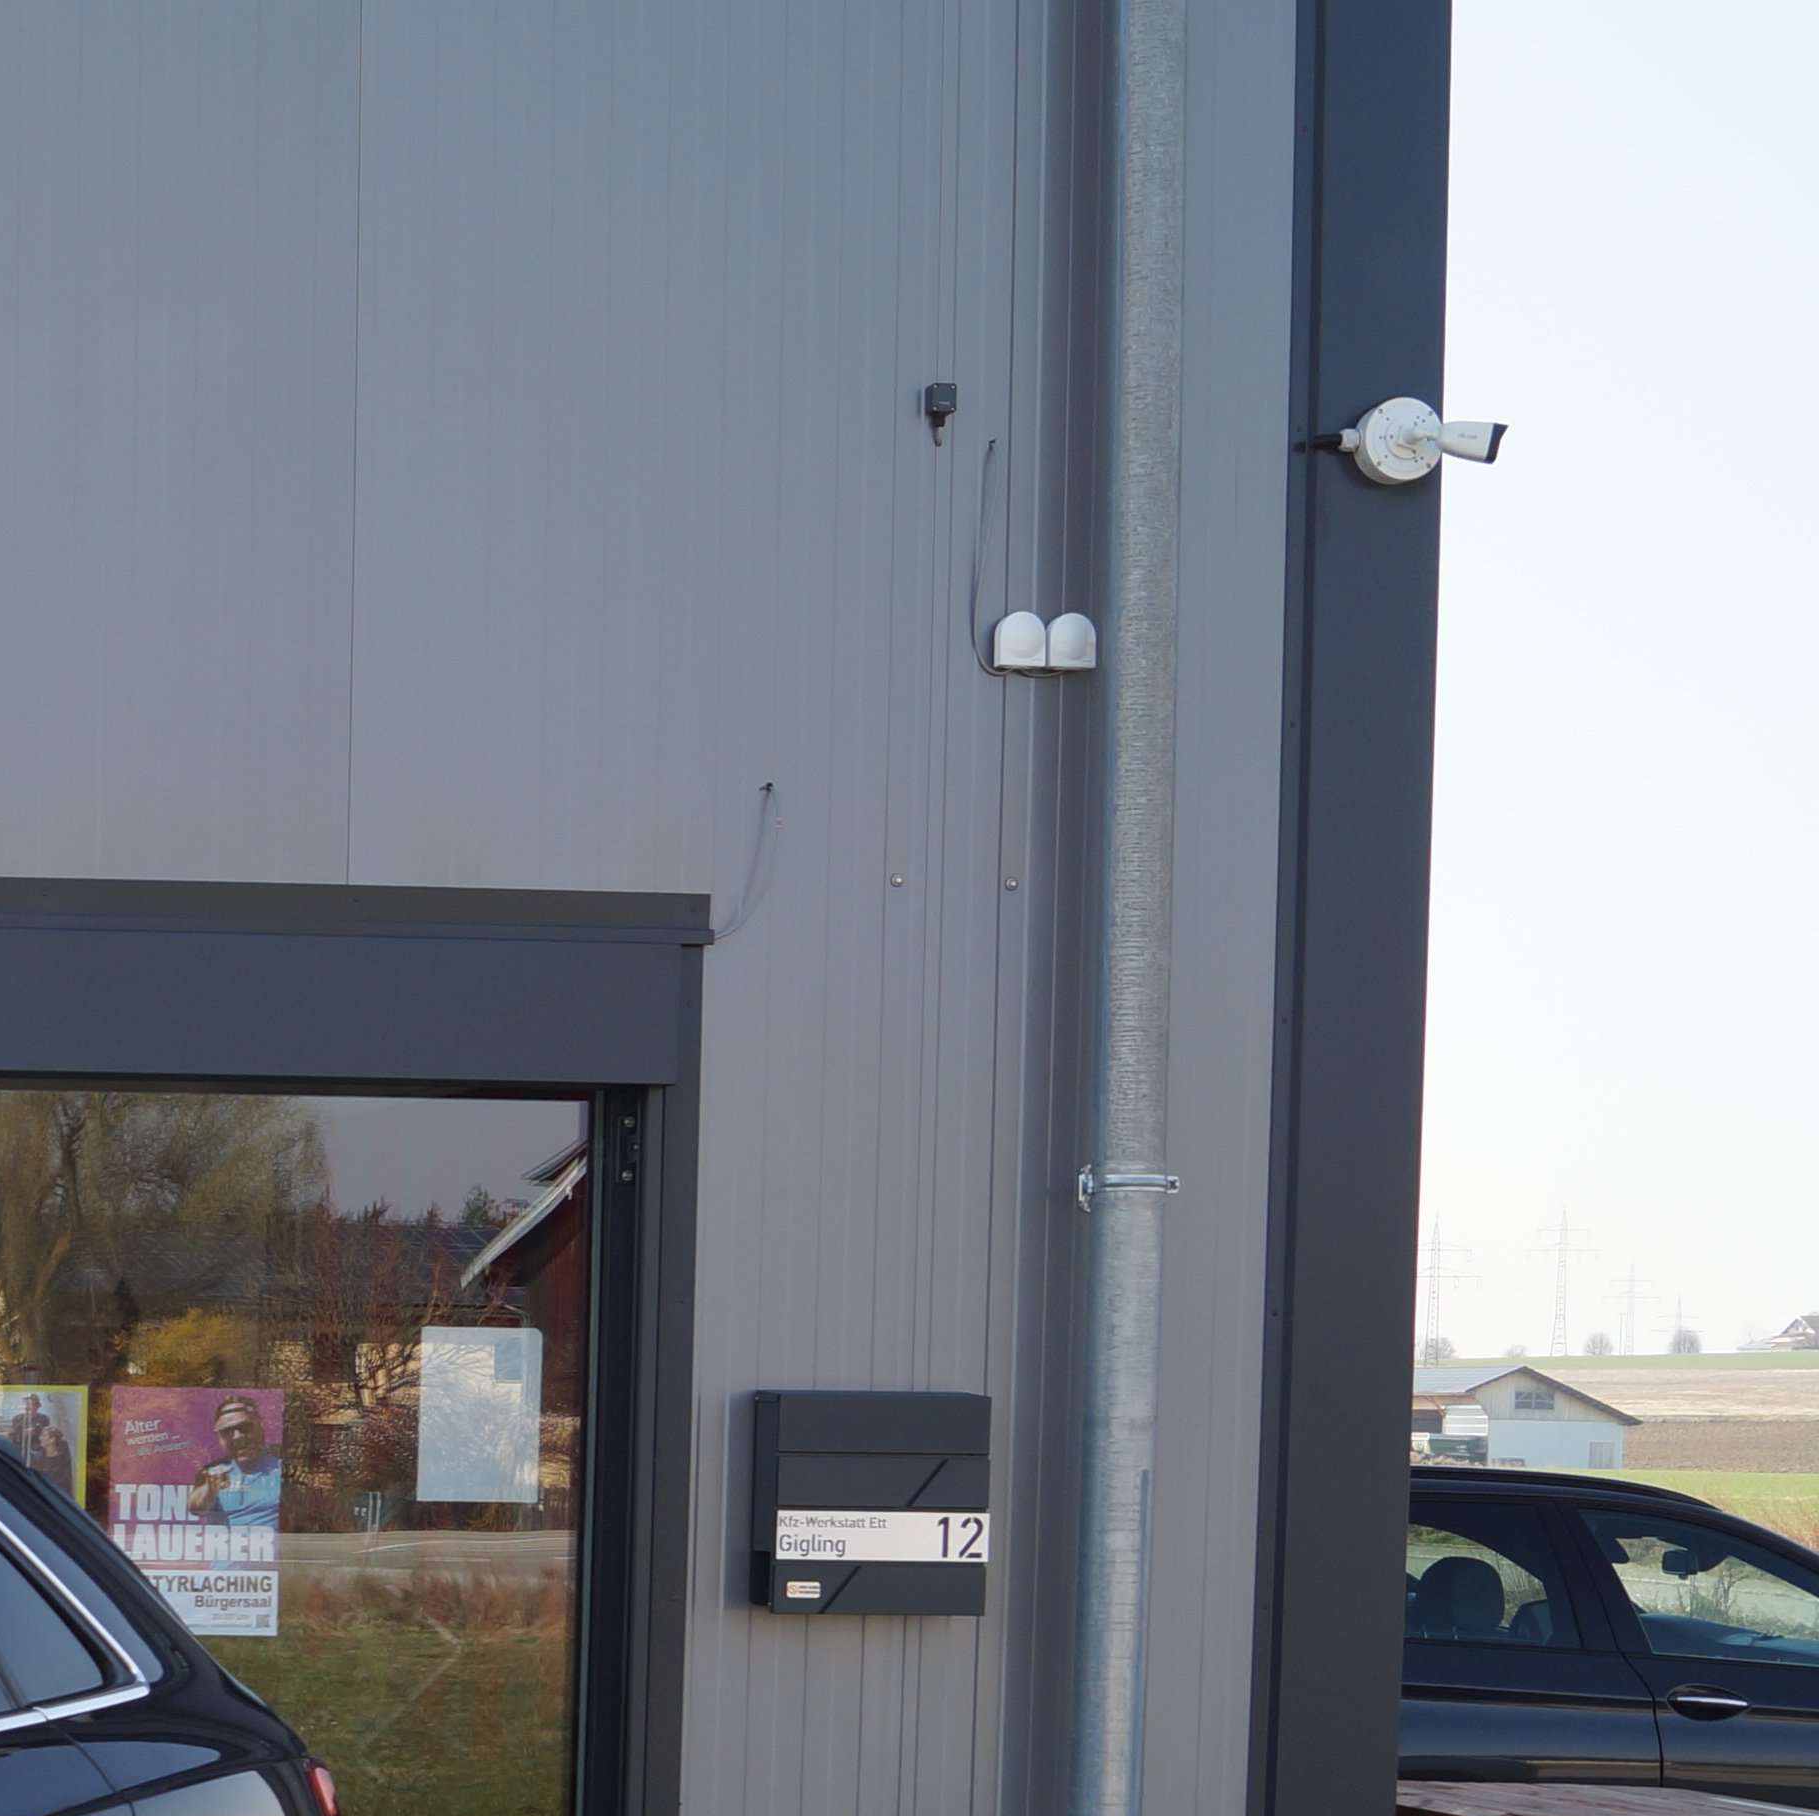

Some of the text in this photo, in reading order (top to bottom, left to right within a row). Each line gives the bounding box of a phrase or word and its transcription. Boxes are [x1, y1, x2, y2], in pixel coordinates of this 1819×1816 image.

[778, 1515, 887, 1528] Kfz-Werkstatt Ett
[778, 1534, 846, 1557] Gigling
[937, 1517, 984, 1559] 12
[195, 1595, 272, 1610] Bürgersaal
